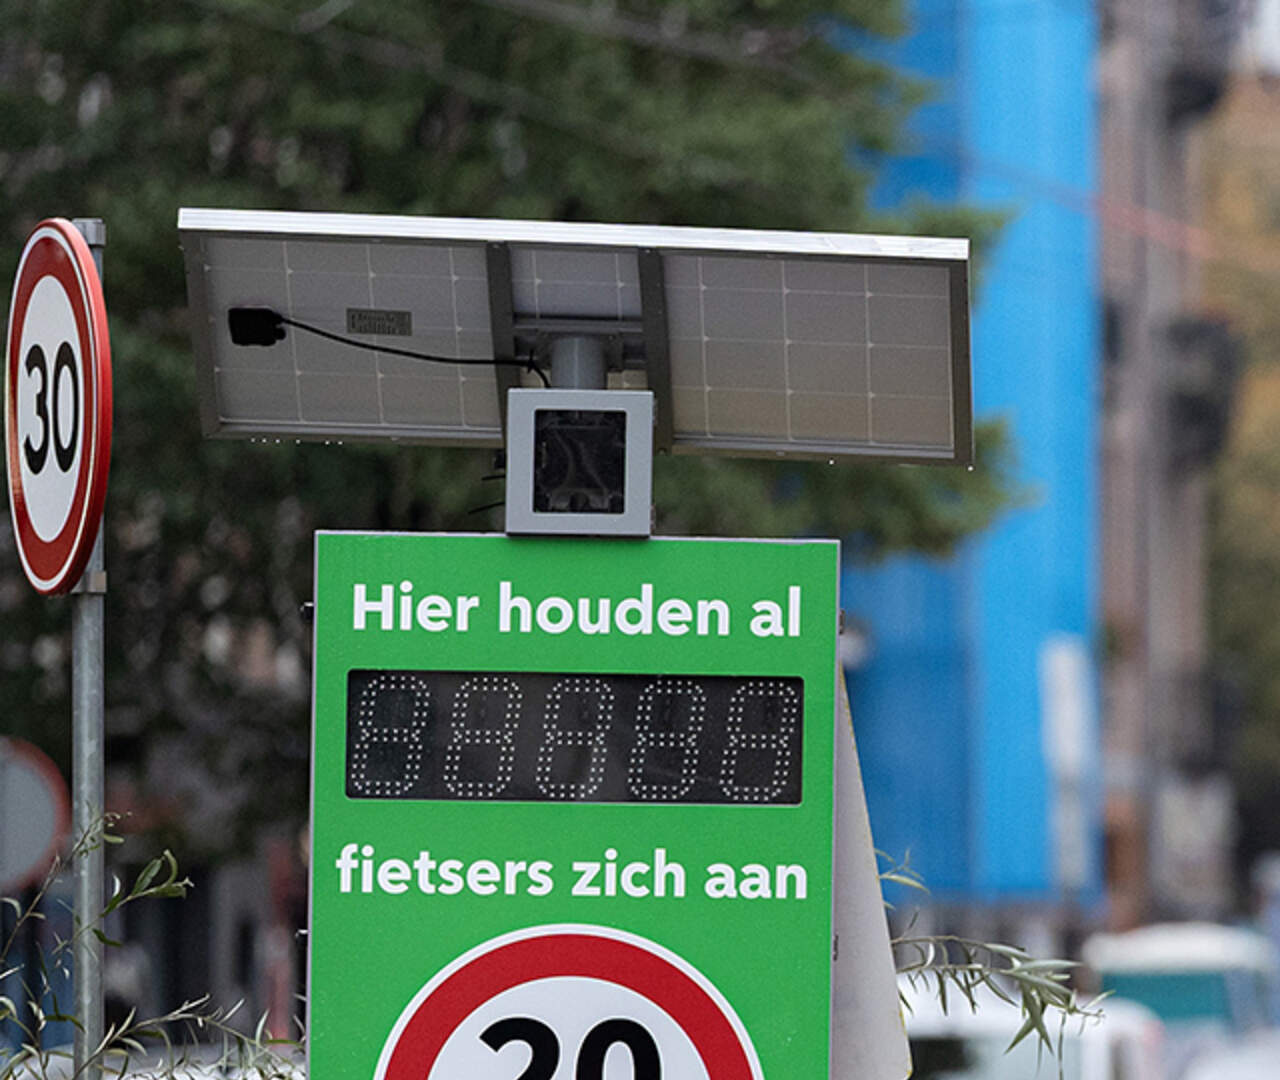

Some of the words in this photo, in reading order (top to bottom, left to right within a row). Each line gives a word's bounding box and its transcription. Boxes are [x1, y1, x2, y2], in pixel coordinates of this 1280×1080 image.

[22, 342, 80, 476] 30
[352, 579, 482, 633] Hier
[498, 580, 732, 637] houden
[749, 584, 802, 638] al
[335, 843, 554, 897] fietsers
[570, 847, 687, 899] zich
[703, 862, 808, 900] aan
